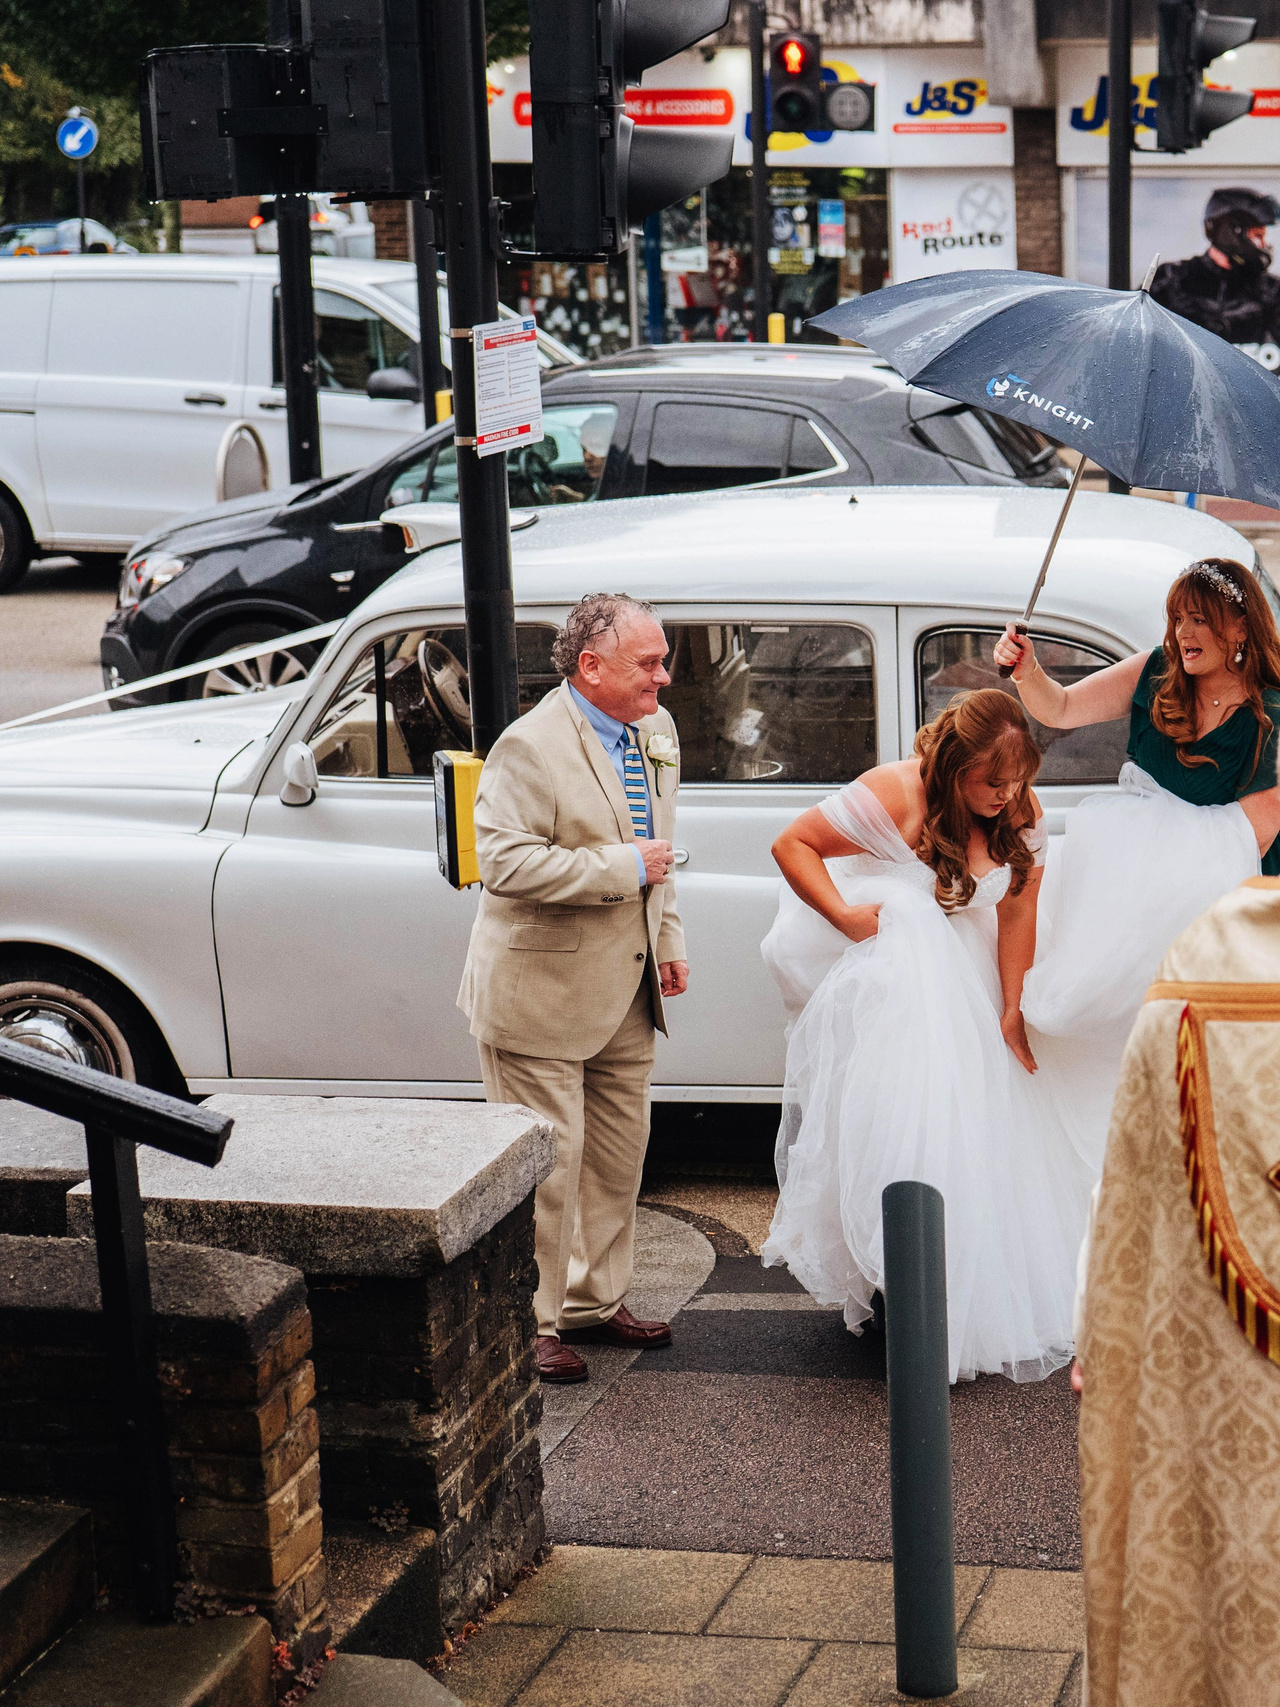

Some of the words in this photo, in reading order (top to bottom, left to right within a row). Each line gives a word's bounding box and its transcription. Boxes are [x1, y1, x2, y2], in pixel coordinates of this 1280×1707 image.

[906, 80, 977, 116] J&S
[902, 217, 953, 240] Red
[924, 230, 1004, 256] Route
[1013, 387, 1095, 430] KNIGHT
